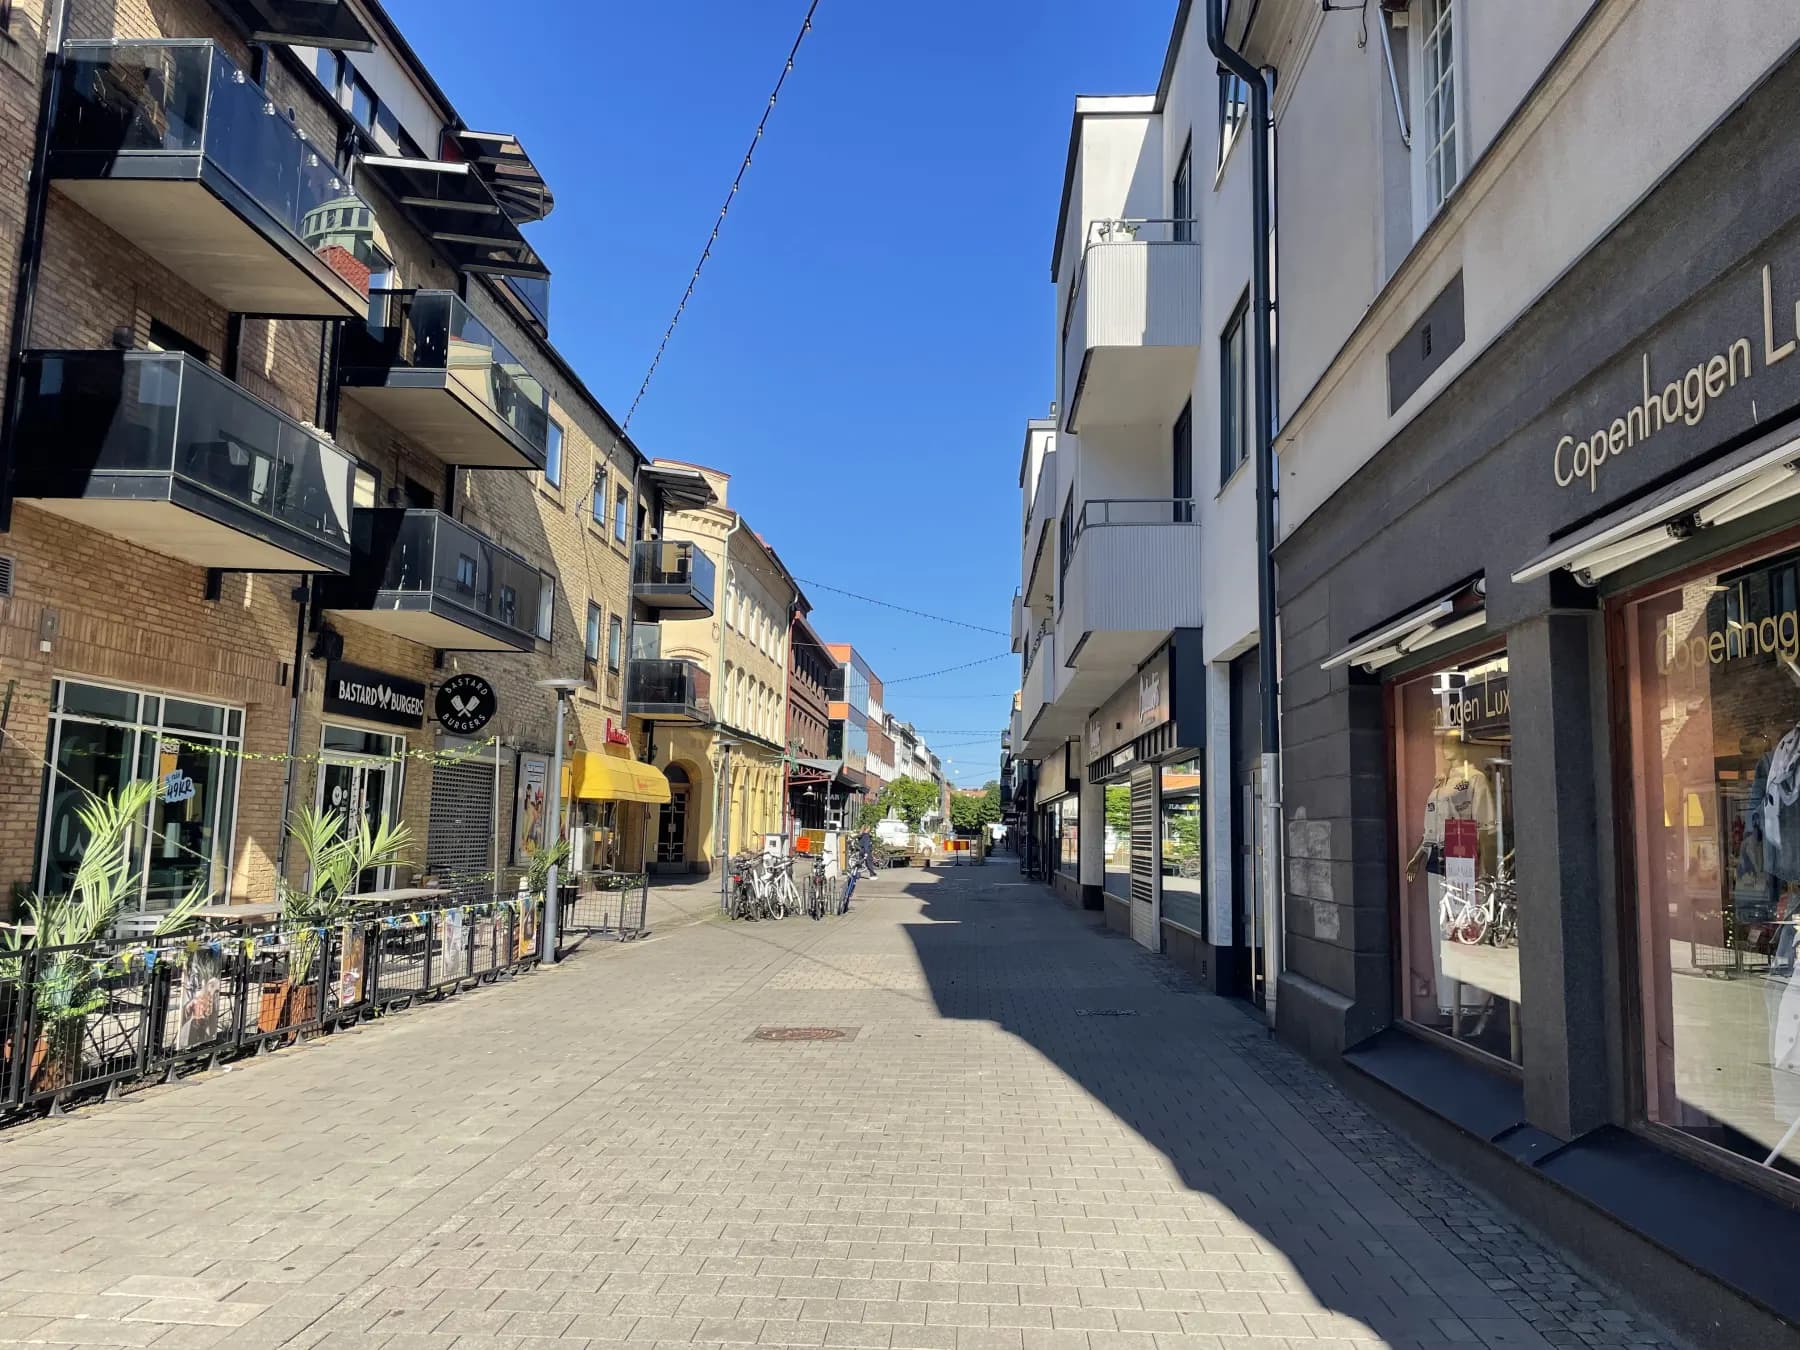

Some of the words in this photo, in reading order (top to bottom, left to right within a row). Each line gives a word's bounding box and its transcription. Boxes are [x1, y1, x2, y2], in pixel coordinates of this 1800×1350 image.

[1553, 338, 1752, 493] Copenhagen
[1762, 264, 1800, 366] L
[339, 680, 377, 706] BASTARD
[391, 693, 423, 716] BURGERS
[445, 677, 488, 696] BASTARD
[442, 713, 486, 730] BURGERS
